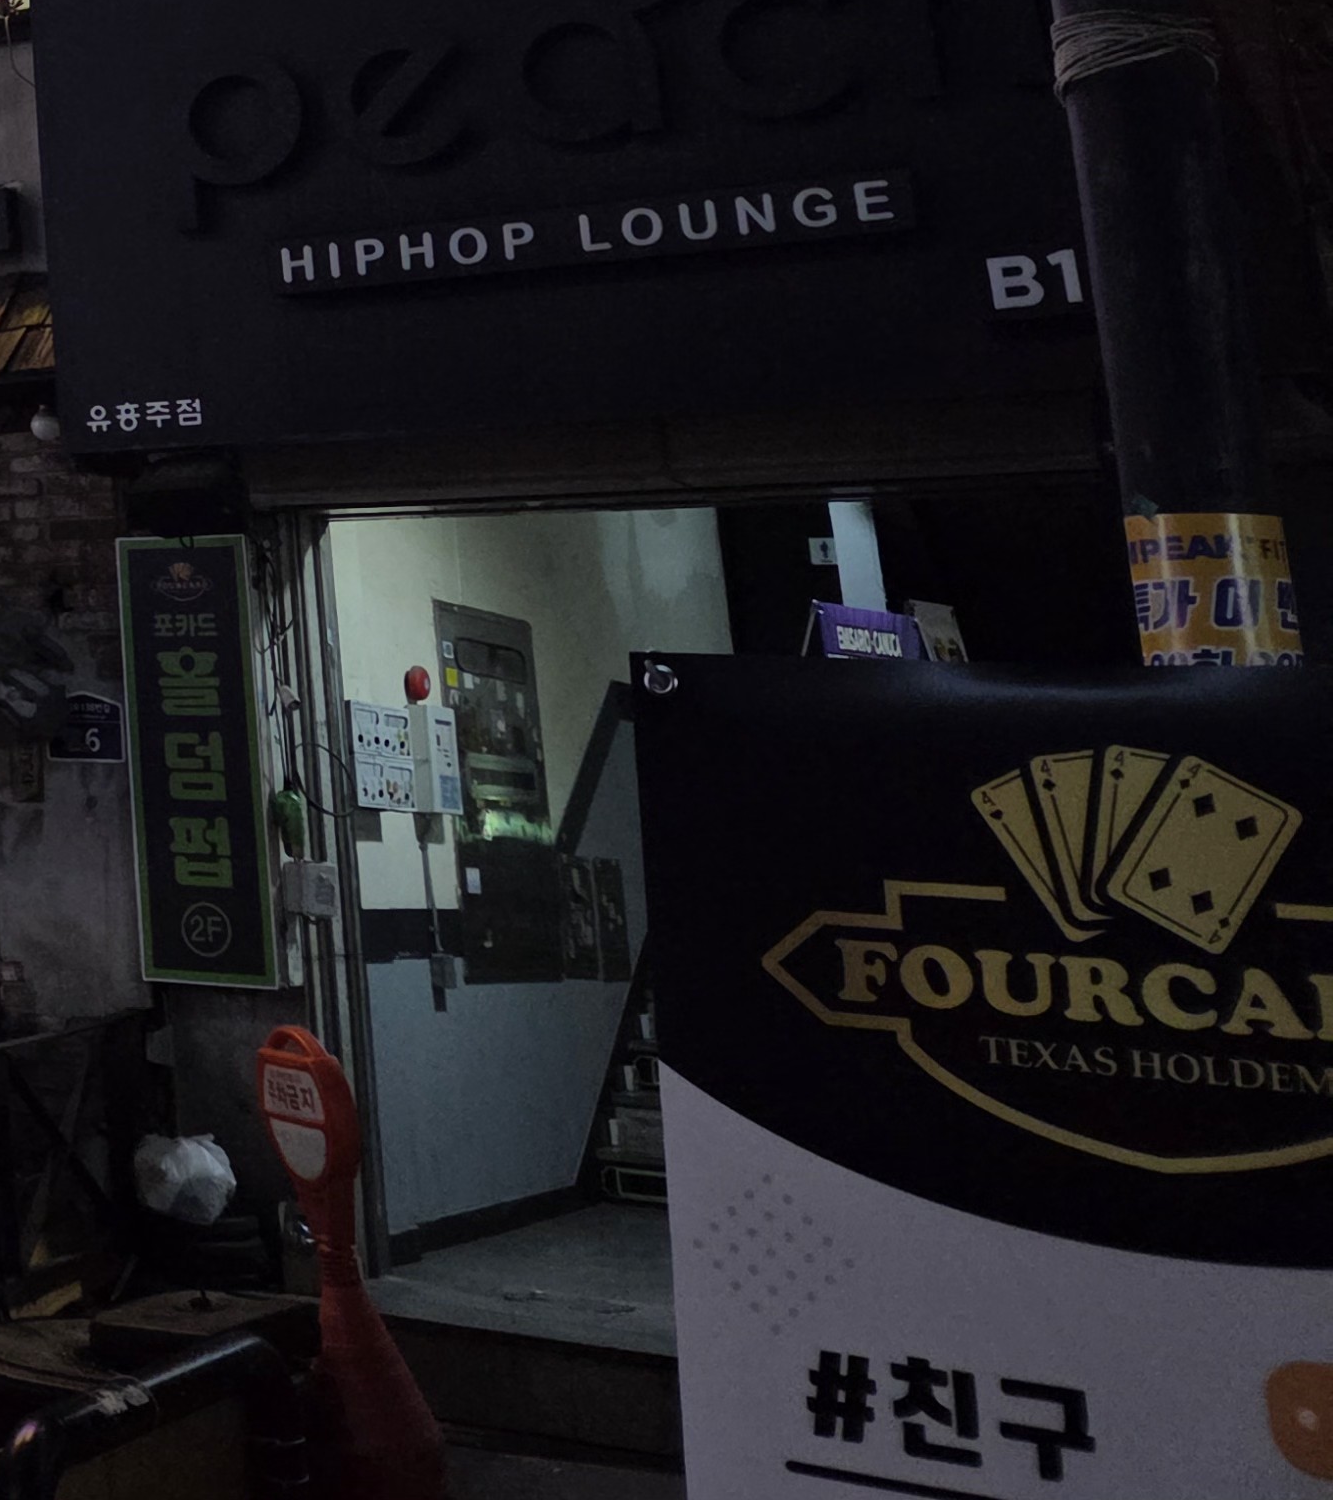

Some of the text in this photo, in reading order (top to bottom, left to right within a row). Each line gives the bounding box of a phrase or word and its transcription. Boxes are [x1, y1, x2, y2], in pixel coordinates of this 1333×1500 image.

[281, 180, 898, 285] HIPHOP LOUNGE
[85, 397, 202, 432] 유흥주점
[154, 612, 218, 638] 포카드
[83, 727, 102, 754] 6
[157, 645, 235, 889] 홀덤펍
[190, 915, 224, 942] 2F
[979, 1035, 1333, 1097] TEXAS HOLDEM
[804, 1350, 1095, 1482] #친구
